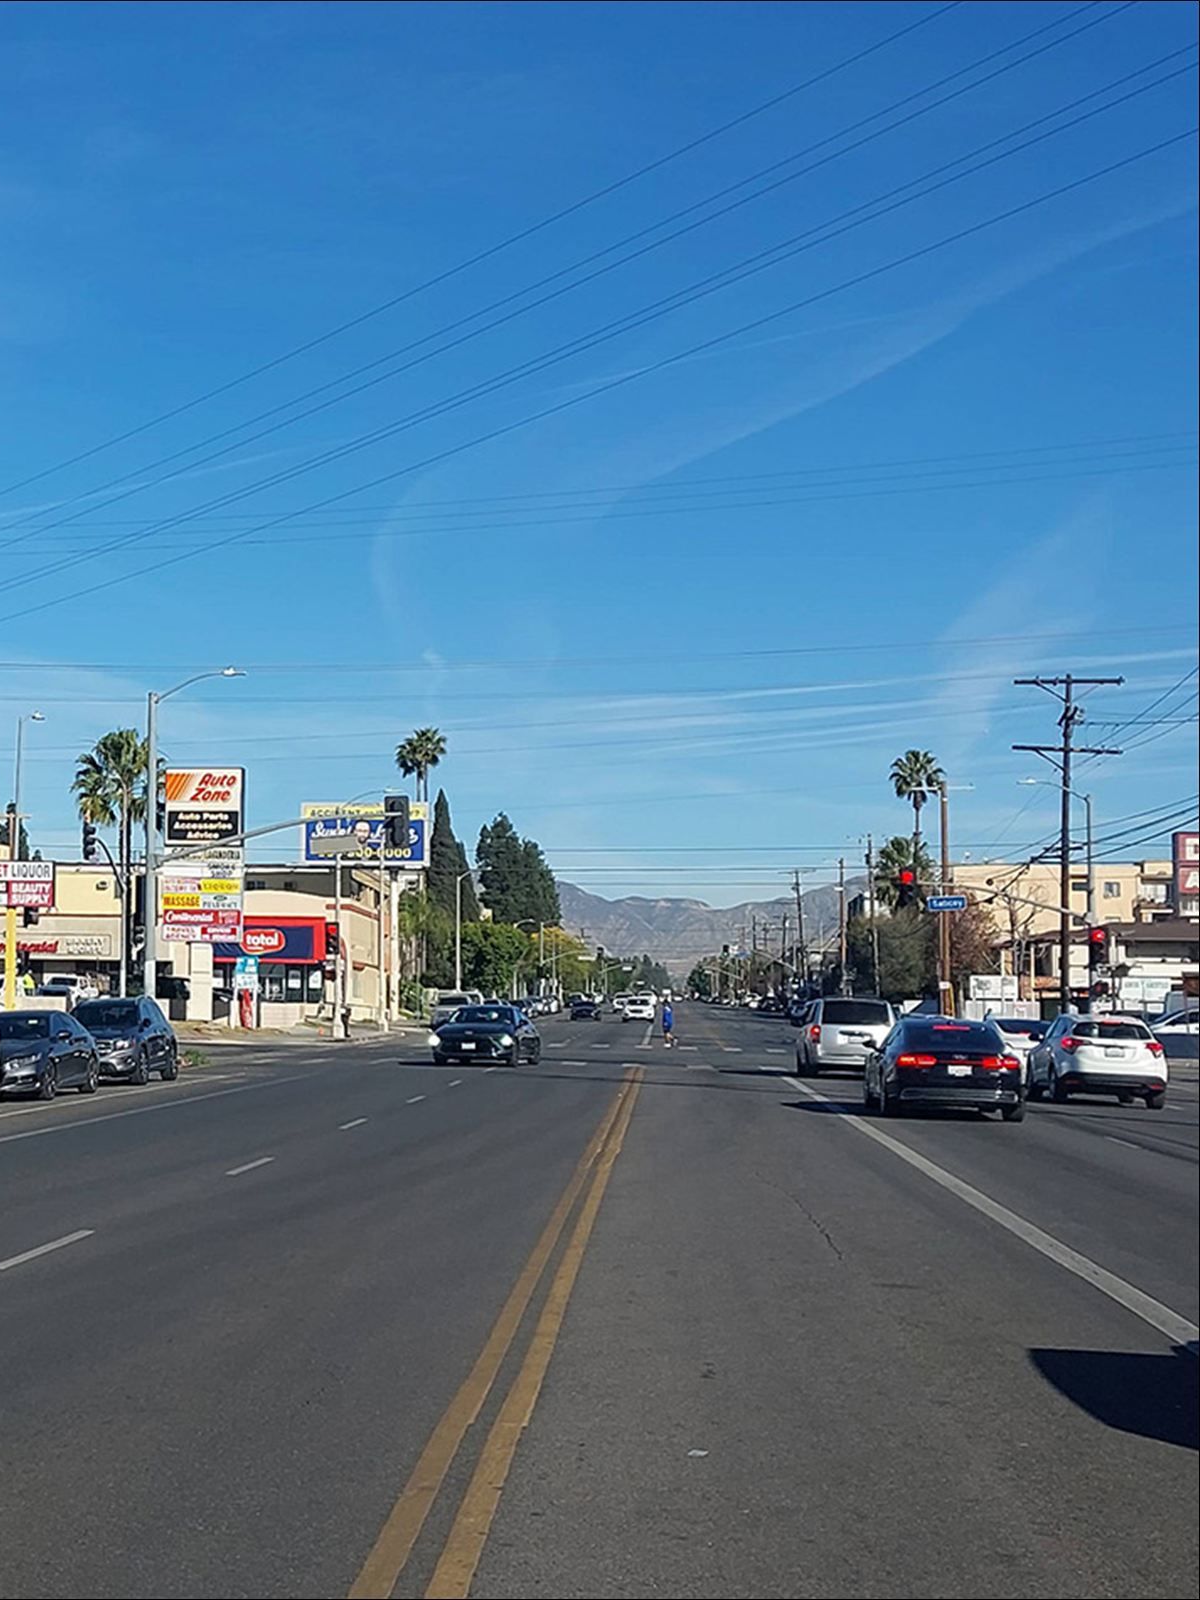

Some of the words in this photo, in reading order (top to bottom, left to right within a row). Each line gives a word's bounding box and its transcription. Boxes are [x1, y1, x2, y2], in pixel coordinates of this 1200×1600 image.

[199, 773, 236, 786] Auto
[189, 787, 231, 802] Zone
[178, 812, 200, 821] Auto
[202, 812, 229, 821] Parts
[173, 821, 234, 830] Accessories
[186, 831, 220, 839] Advice
[11, 864, 50, 878] LIQUOR
[11, 882, 51, 893] BEAUTY
[11, 893, 50, 904] SUPPLY
[164, 896, 200, 907] MASSAGE
[166, 911, 214, 924] Continental
[246, 932, 279, 946] total
